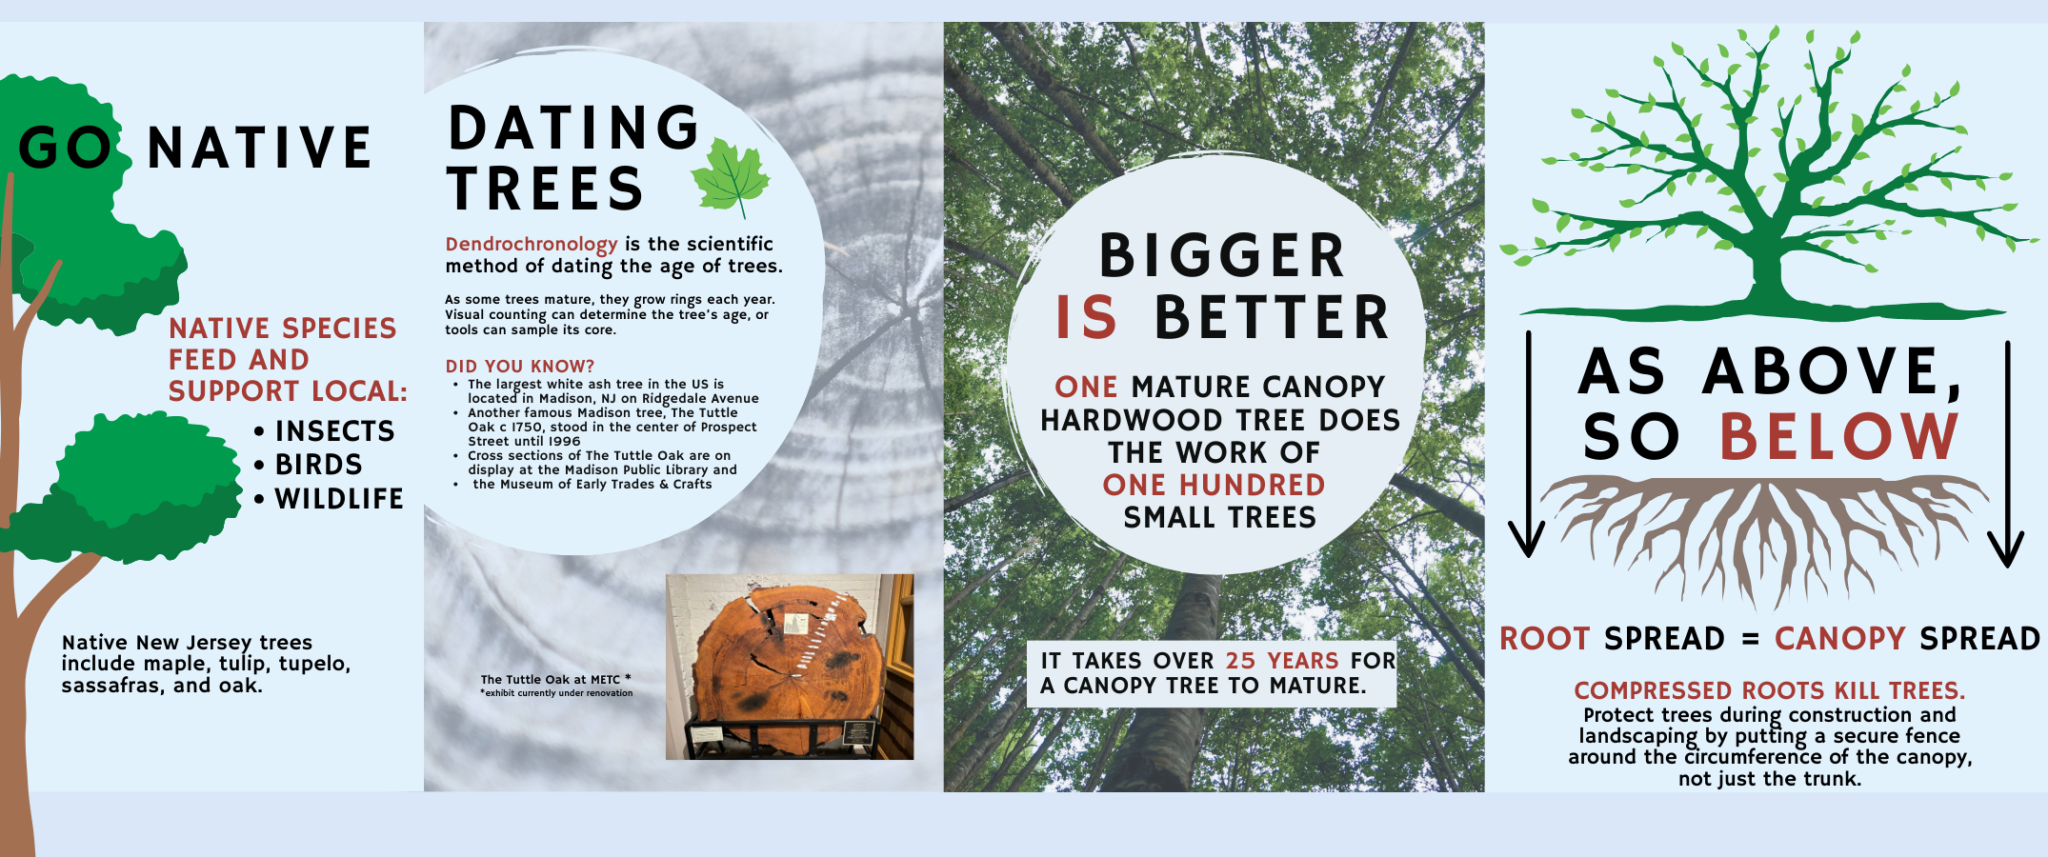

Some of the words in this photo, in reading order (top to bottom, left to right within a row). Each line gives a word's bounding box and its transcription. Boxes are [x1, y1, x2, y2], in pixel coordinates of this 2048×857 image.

[450, 104, 697, 151] DATING
[18, 125, 111, 169] GO
[149, 125, 370, 168] NATIVE
[445, 164, 642, 212] TREES
[446, 235, 619, 258] Dendrochronology
[625, 234, 641, 252] is
[647, 235, 680, 252] the
[687, 234, 774, 252] scientific
[1101, 231, 1344, 278] BIGGER
[444, 294, 461, 305] As
[465, 295, 501, 305] some
[504, 294, 540, 305] trees
[544, 294, 595, 307] mature,
[599, 293, 630, 308] they
[633, 295, 666, 310] grow
[670, 293, 703, 310] rings
[706, 293, 739, 305] each
[743, 295, 776, 308] year.
[169, 316, 269, 339] NATIVE
[282, 316, 397, 339] SPECIES
[1057, 293, 1116, 340] IS
[1156, 293, 1389, 340] BETTER
[444, 323, 479, 336] tools
[482, 326, 507, 336] can
[511, 323, 559, 338] sample
[563, 323, 580, 336] its
[584, 326, 617, 336] core.
[169, 348, 237, 371] FEED
[248, 348, 309, 371] AND
[446, 359, 477, 374] DID
[484, 359, 523, 374] YOU
[531, 358, 595, 374] KNOW?
[467, 378, 492, 390] The
[496, 377, 543, 395] largest
[546, 377, 584, 390] white
[588, 378, 612, 390] ash
[615, 379, 643, 390] tree
[648, 377, 660, 390] in
[664, 378, 687, 390] the
[691, 378, 709, 390] US
[713, 377, 725, 390] is
[1054, 374, 1118, 399] ONE
[1132, 374, 1250, 399] MATURE
[1262, 374, 1386, 399] CANOPY
[1576, 345, 1664, 395] AS
[1701, 345, 1960, 405] ABOVE,
[169, 379, 300, 402] SUPPORT
[312, 379, 407, 402] LOCAL:
[468, 392, 518, 404] located
[522, 395, 534, 404] in
[539, 392, 597, 406] Madison,
[601, 393, 616, 404] NJ
[620, 395, 637, 404] on
[642, 392, 707, 407] Ridgedale
[710, 393, 760, 404] Avenue
[467, 406, 521, 418] Another
[524, 406, 573, 418] famous
[577, 406, 631, 418] Madison
[635, 407, 667, 420] tree,
[670, 406, 695, 418] The
[698, 406, 738, 418] Tuttle
[1041, 407, 1223, 432] HARDWOOD
[1235, 407, 1305, 432] TREE
[1319, 407, 1401, 432] DOES
[276, 419, 395, 443] INSECTS
[468, 435, 510, 447] Street
[514, 435, 544, 447] until
[549, 435, 581, 447] 1996
[1584, 411, 1680, 461] SO
[1721, 411, 1959, 461] BELOW
[467, 450, 504, 461] Cross
[508, 450, 564, 461] sections
[567, 449, 582, 461] of
[585, 449, 610, 461] The
[613, 449, 653, 461] Tuttle
[657, 449, 685, 461] Oak
[689, 452, 711, 461] are
[714, 452, 731, 461] on
[1107, 440, 1163, 464] THE
[1174, 440, 1268, 464] WORK
[1279, 440, 1320, 464] OF
[276, 452, 363, 476] BIRDS
[472, 478, 496, 490] the
[500, 478, 554, 490] Museum
[557, 477, 573, 490] of
[576, 477, 607, 493] Early
[610, 477, 655, 490] Trades
[659, 478, 669, 490] &
[672, 477, 713, 490] Crafts
[1102, 472, 1166, 497] ONE
[1180, 472, 1325, 497] HUNDRED
[273, 486, 404, 510] WILDLIFE
[1124, 505, 1216, 529] SMALL
[1227, 505, 1317, 529] TREES
[62, 632, 128, 651] Native
[136, 634, 180, 651] New
[186, 634, 253, 656] Jersey
[259, 634, 313, 651] trees
[1500, 625, 1591, 651] ROOT
[1604, 625, 1725, 651] SPREAD
[1741, 632, 1760, 646] =
[1775, 625, 1907, 651] CANOPY
[1920, 625, 2041, 651] SPREAD
[62, 653, 136, 672] include
[144, 653, 211, 676] maple,
[218, 653, 271, 676] tulip,
[278, 653, 351, 676] tupelo,
[1041, 651, 1062, 670] IT
[1071, 651, 1142, 670] TAKES
[1153, 651, 1214, 670] OVER
[1226, 651, 1256, 670] 25
[1267, 651, 1339, 670] YEARS
[1351, 651, 1396, 670] FOR
[61, 675, 165, 696] sassafras,
[173, 675, 211, 694] and
[218, 676, 263, 694] oak.
[480, 674, 503, 685] The
[505, 673, 542, 685] Tuttle
[545, 674, 571, 685] Oak
[573, 674, 587, 685] at
[590, 674, 621, 685] METC
[1039, 676, 1056, 694] A
[1063, 676, 1158, 695] CANOPY
[1165, 676, 1219, 694] TREE
[1227, 676, 1260, 695] TO
[1270, 676, 1367, 695] MATURE.
[1574, 680, 1732, 700] COMPRESSED
[1742, 680, 1825, 700] ROOTS
[1835, 681, 1880, 700] KILL
[1888, 680, 1965, 700] TREES.
[517, 688, 557, 699] currently
[558, 688, 585, 697] under
[586, 688, 634, 698] renovation
[1584, 706, 1655, 723] Protect
[1661, 707, 1713, 723] trees
[1719, 705, 1782, 730] during
[1788, 705, 1912, 723] construction
[1919, 705, 1957, 723] and
[1568, 747, 1637, 765] around
[1643, 747, 1678, 765] the
[1684, 747, 1823, 765] circumference
[1829, 746, 1850, 765] of
[1855, 747, 1890, 765] the
[1896, 751, 1973, 769] canopy,
[1678, 770, 1713, 787] not
[1716, 769, 1757, 791] just
[1762, 769, 1797, 787] the
[1803, 769, 1862, 787] trunk.
